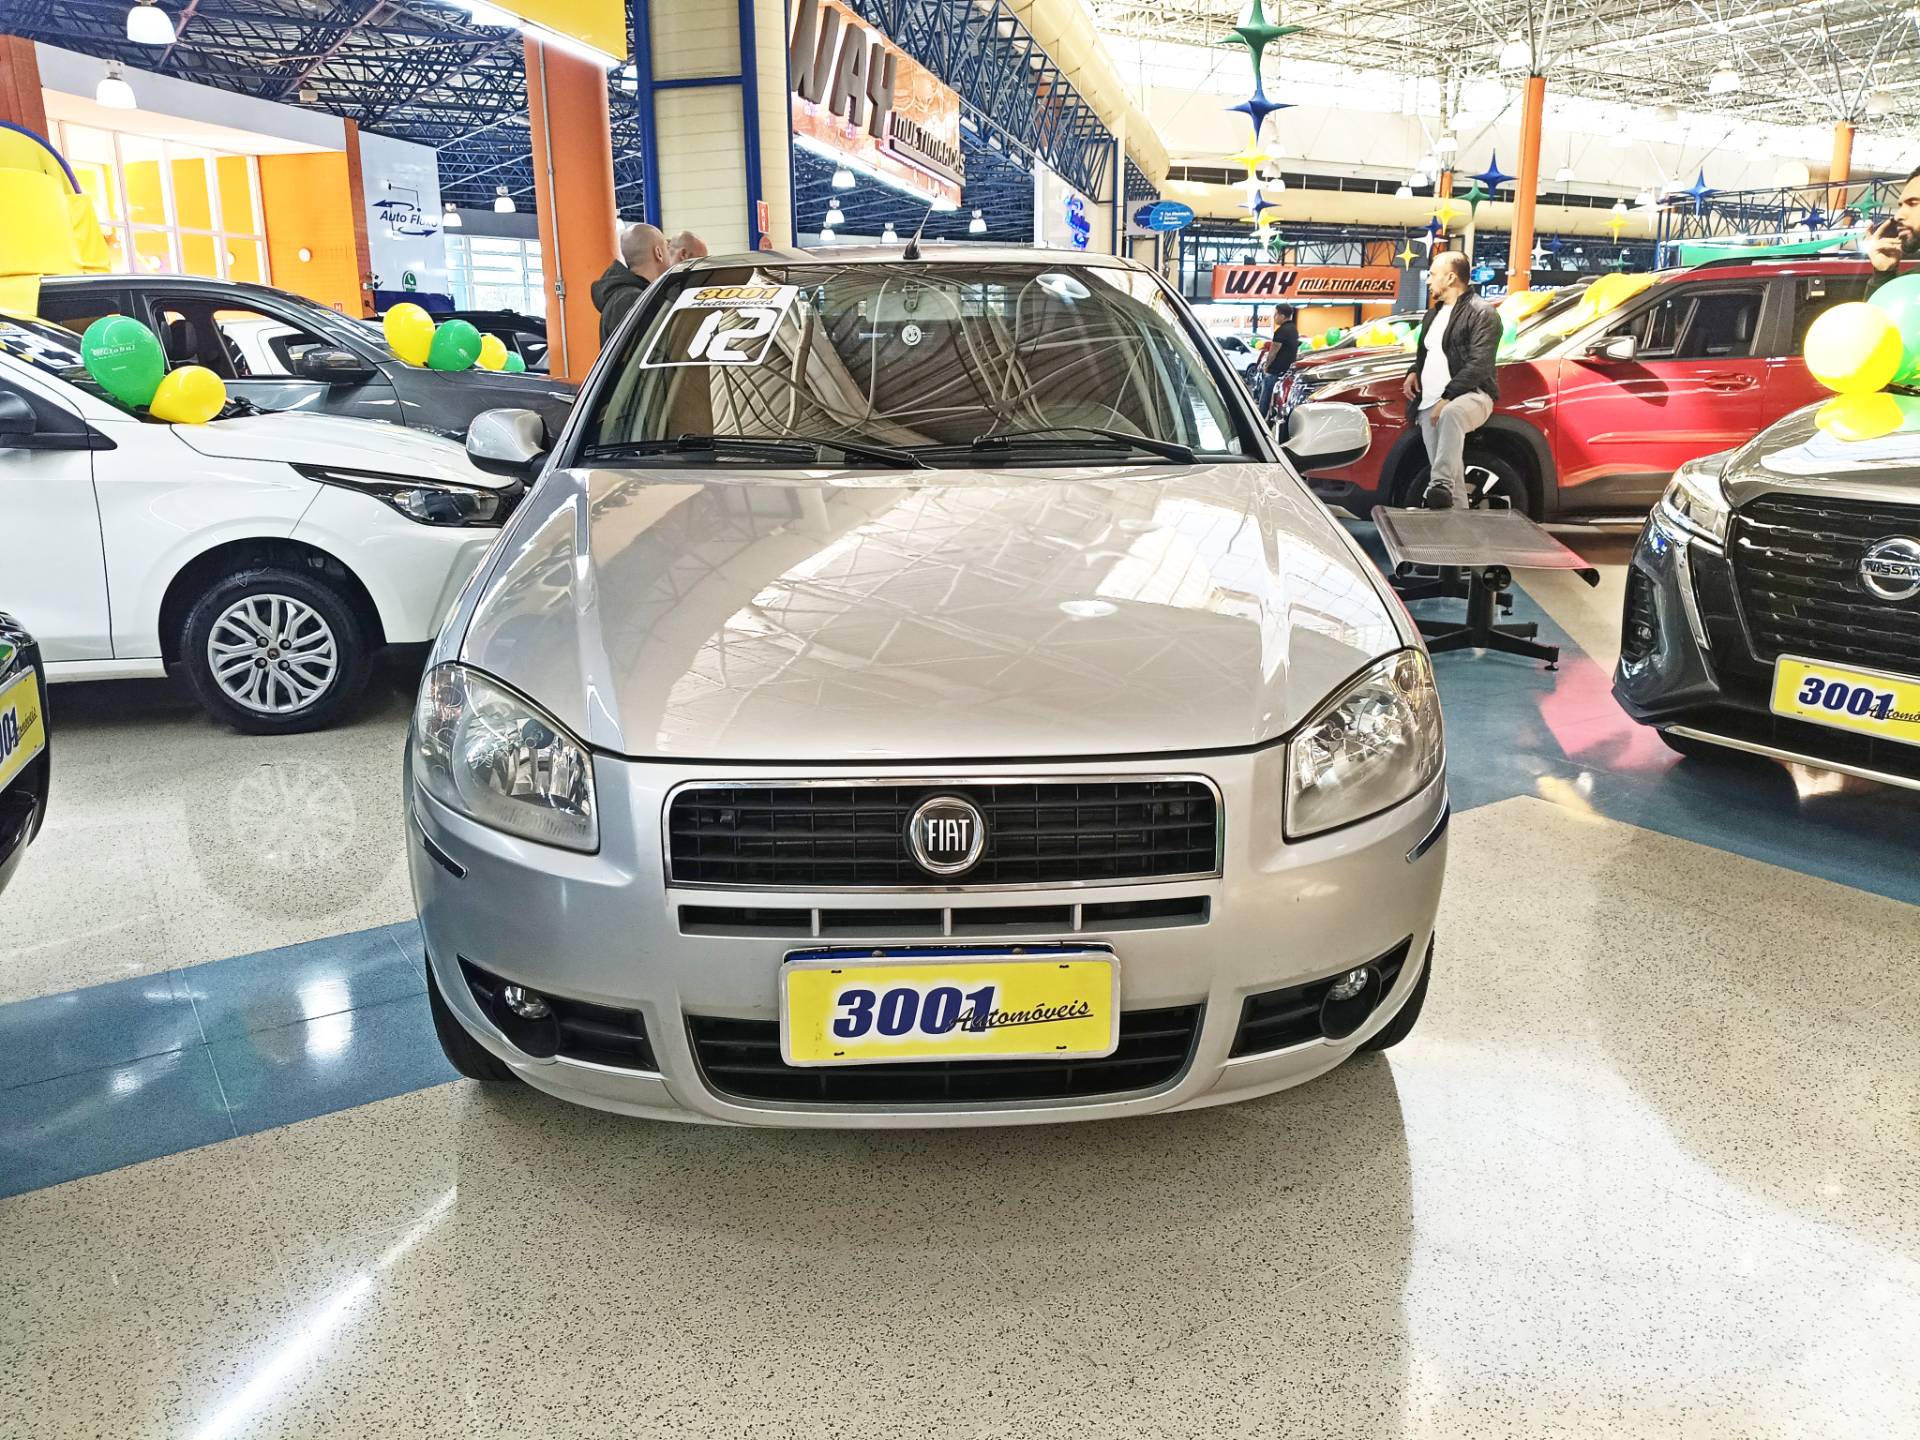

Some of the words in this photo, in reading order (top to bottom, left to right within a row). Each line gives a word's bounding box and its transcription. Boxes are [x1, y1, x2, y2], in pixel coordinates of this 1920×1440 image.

[790, 0, 898, 139] WAY
[380, 210, 407, 223] Auto
[693, 286, 782, 300] 3001
[1225, 270, 1298, 295] WAY
[1299, 278, 1396, 292] MULTIMARCAS
[687, 308, 778, 361] 12
[1865, 560, 1920, 576] NISSAN
[1798, 677, 1894, 720] 3001
[928, 819, 970, 851] FIAT
[833, 986, 995, 1037] 3001
[946, 1000, 1091, 1033] Automóveis
